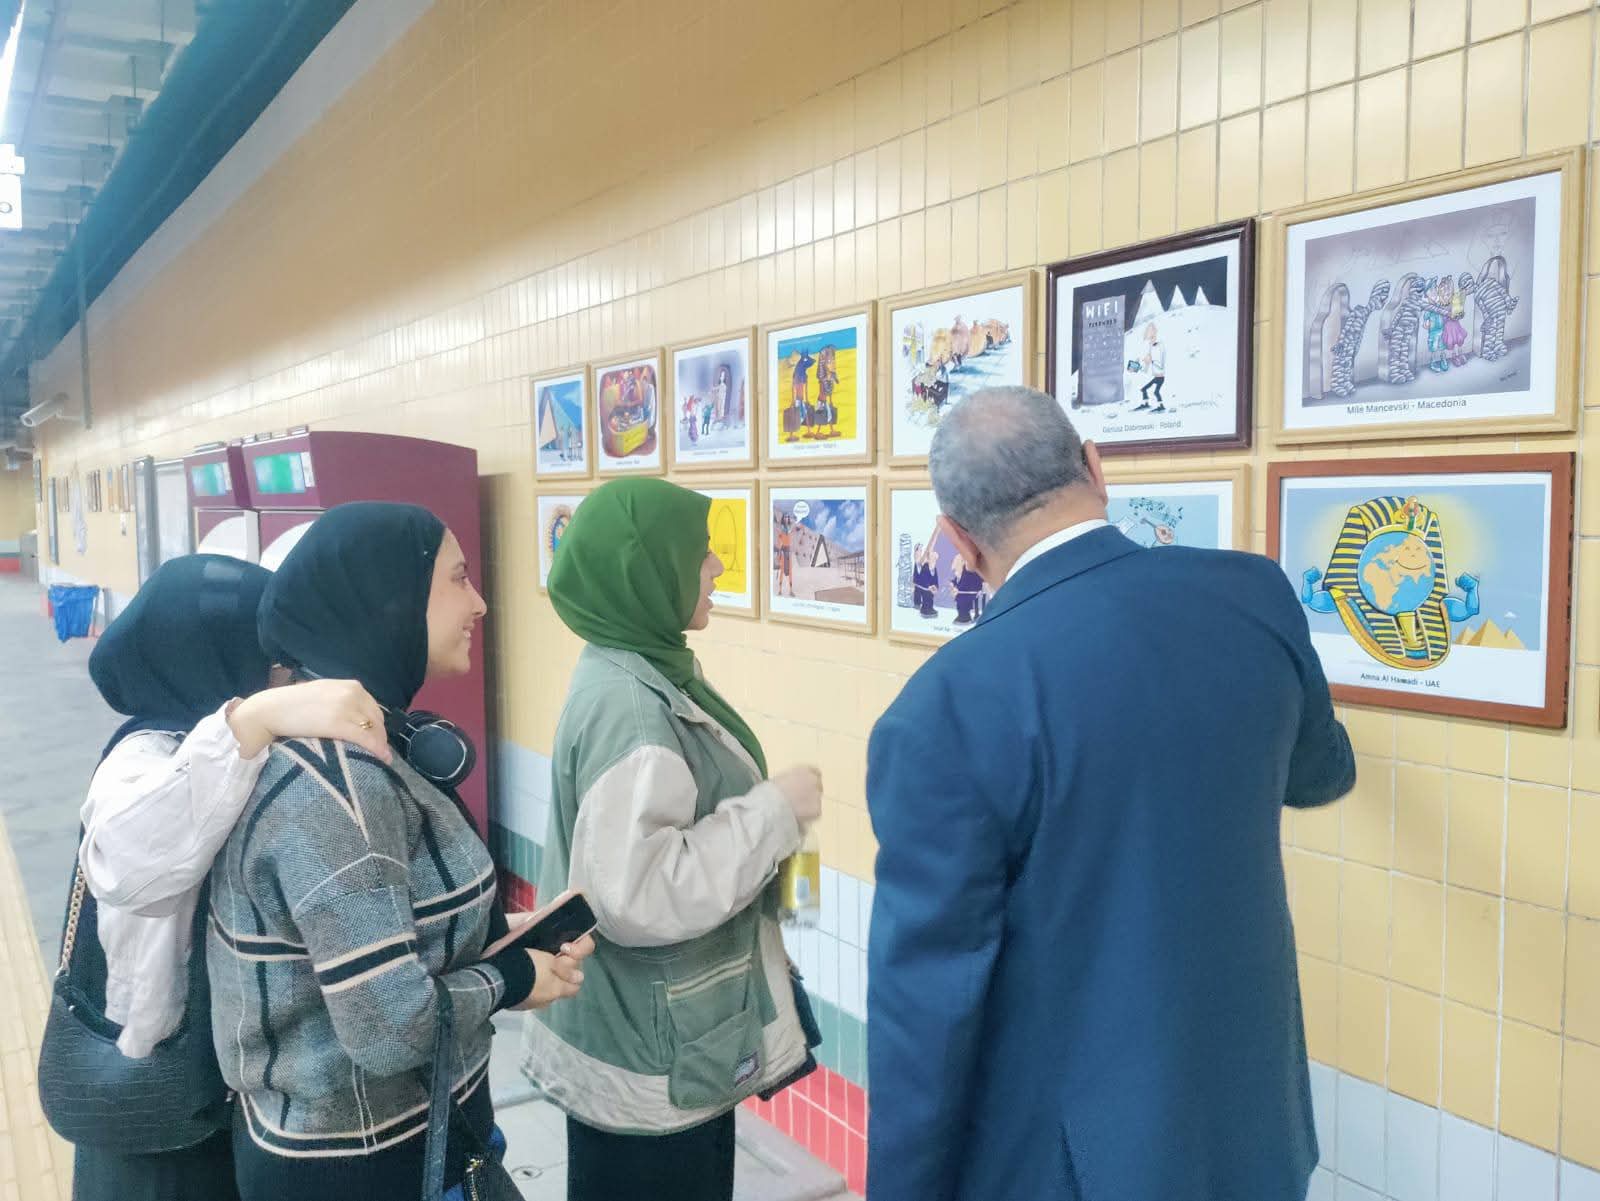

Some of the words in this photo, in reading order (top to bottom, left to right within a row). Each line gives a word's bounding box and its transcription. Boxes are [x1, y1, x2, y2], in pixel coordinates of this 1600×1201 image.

[1086, 301, 1118, 318] WIFI
[1346, 405, 1364, 414] Mile
[1417, 399, 1467, 409] Macedonia
[1159, 420, 1182, 429] Poland
[1425, 680, 1441, 688] UAE
